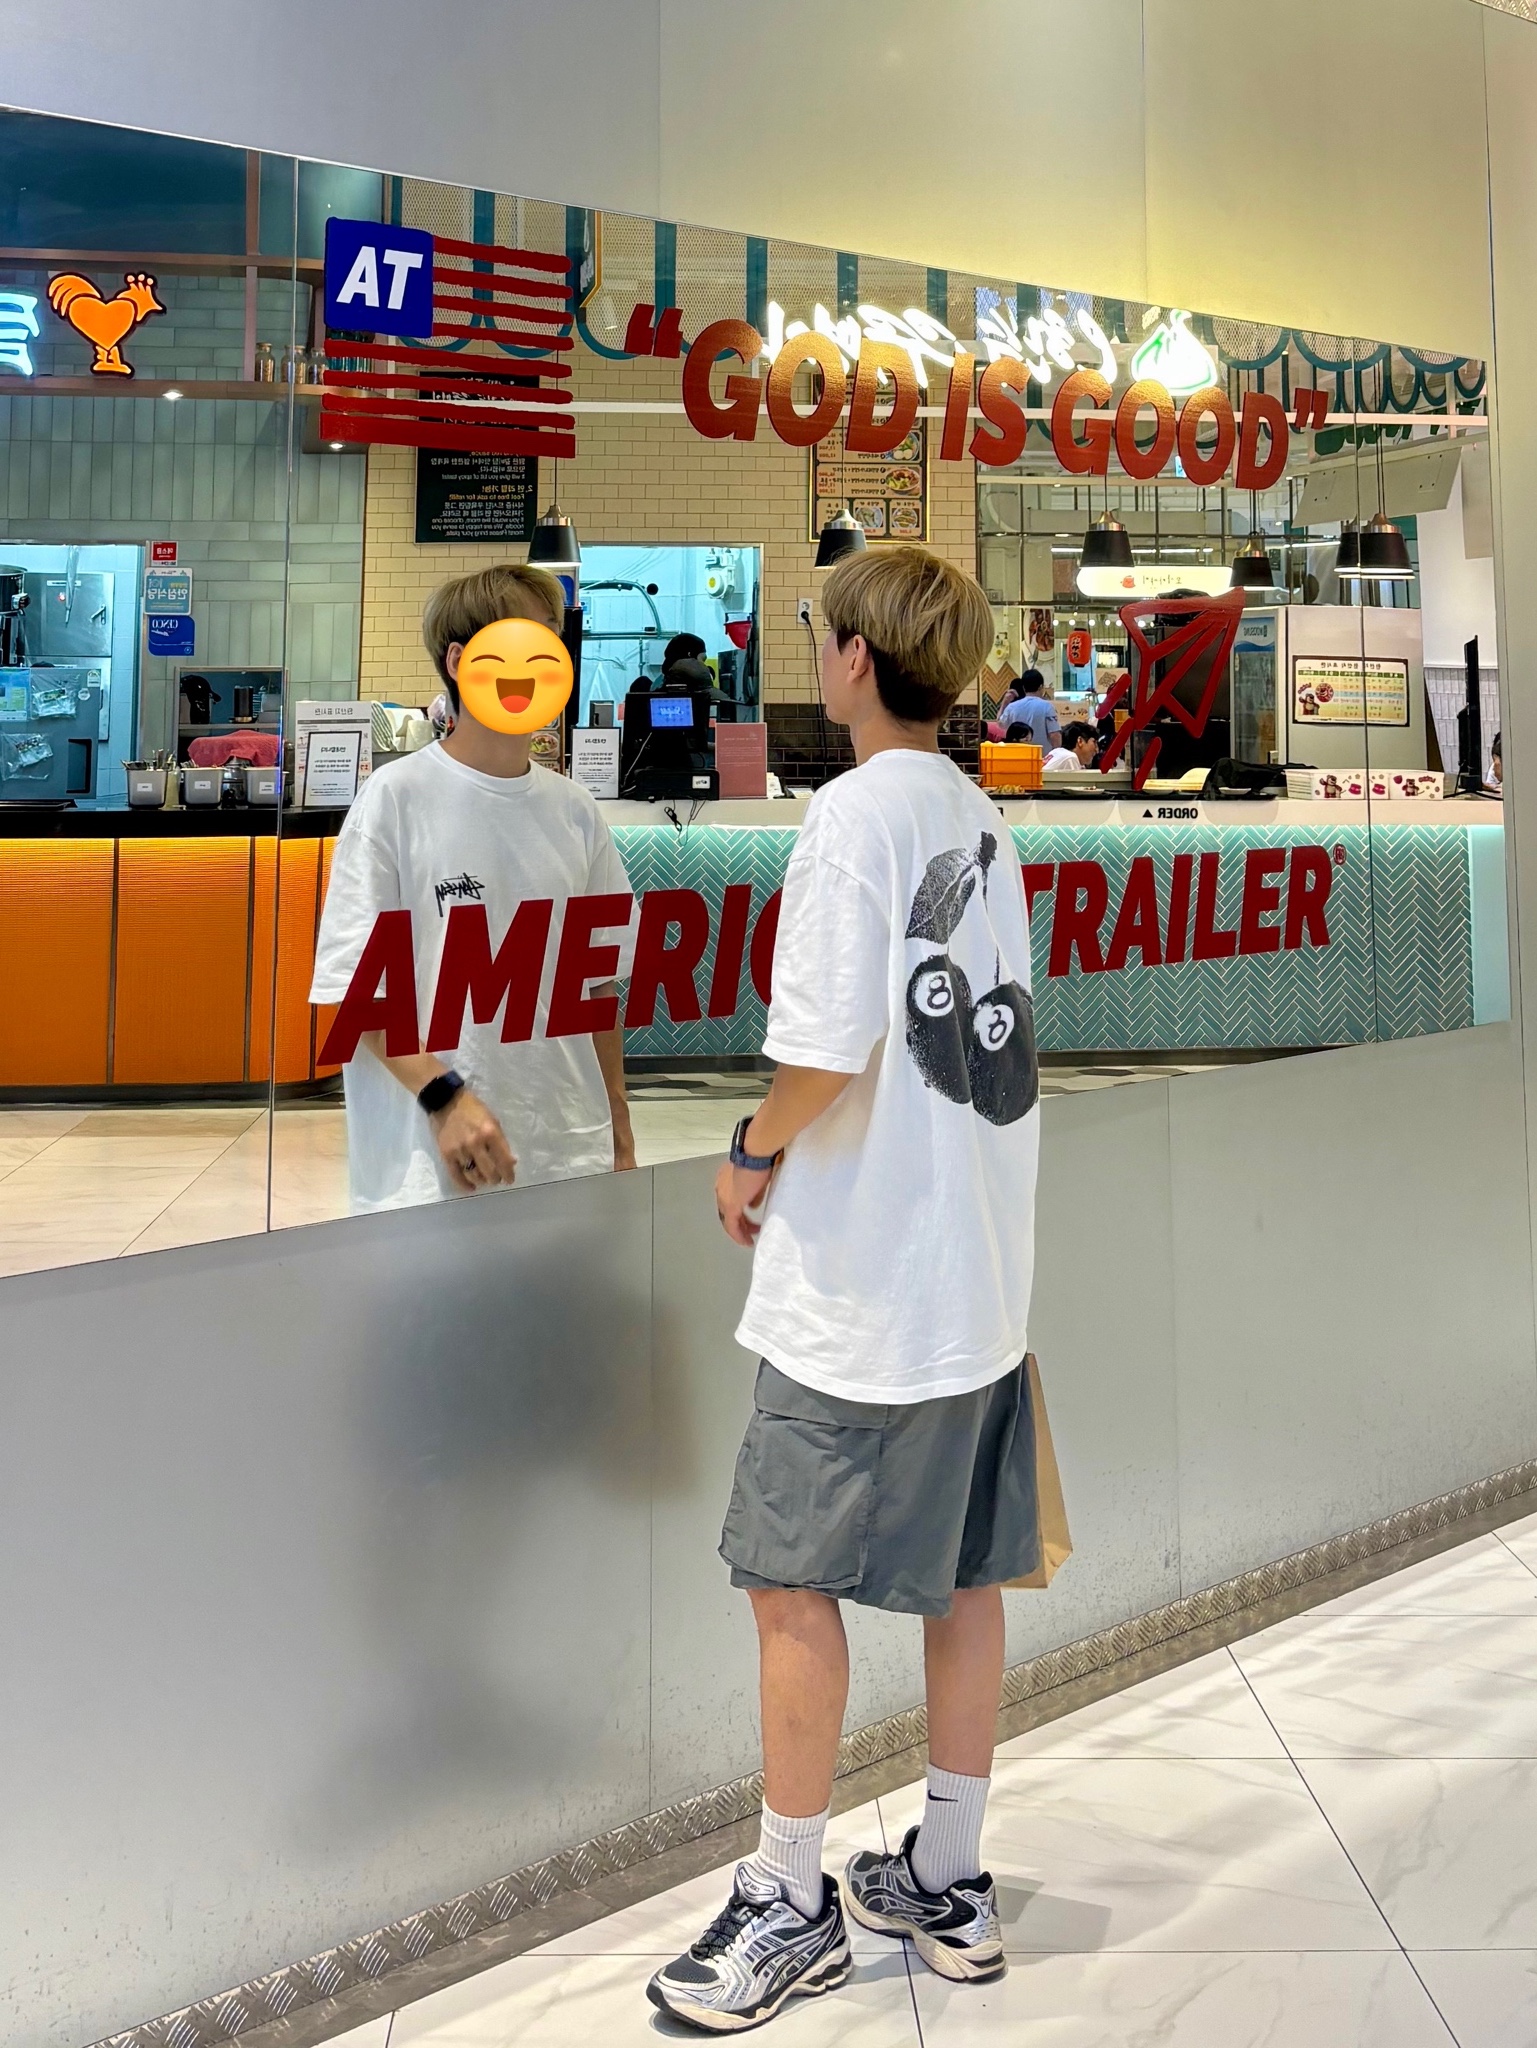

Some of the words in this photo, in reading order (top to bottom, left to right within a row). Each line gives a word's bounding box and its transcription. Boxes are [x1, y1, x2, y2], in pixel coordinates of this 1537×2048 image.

[336, 245, 424, 311] AT
[939, 351, 1031, 467] IS
[317, 883, 782, 1066] AMERI
[927, 974, 951, 1010] 8
